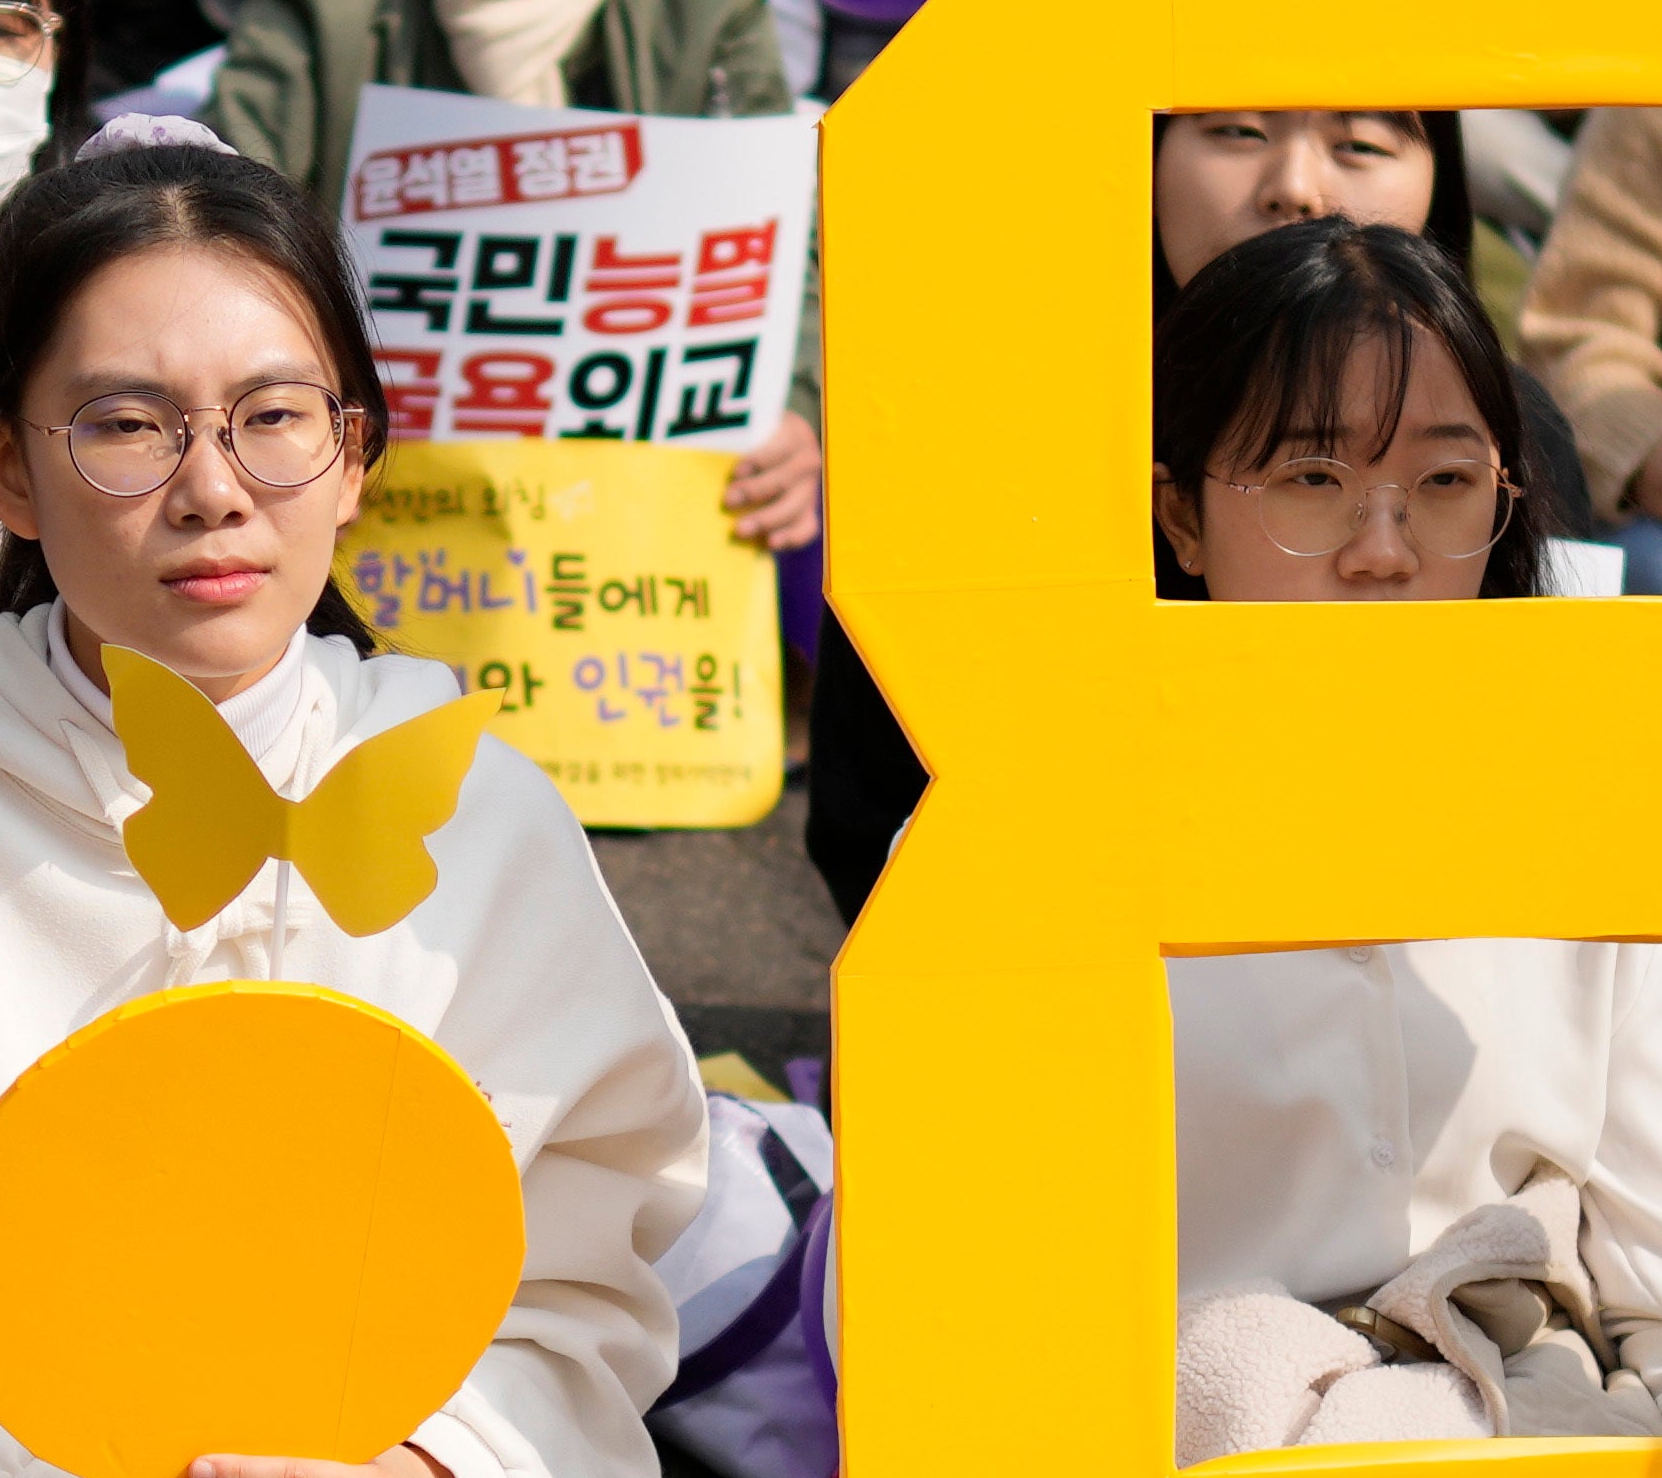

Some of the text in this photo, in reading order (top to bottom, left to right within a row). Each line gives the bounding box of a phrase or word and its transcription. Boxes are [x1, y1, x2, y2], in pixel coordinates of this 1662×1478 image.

[360, 131, 626, 216] 윤석열 정권
[355, 548, 710, 630] 할머니들에게
[574, 650, 743, 731] 인권을!
